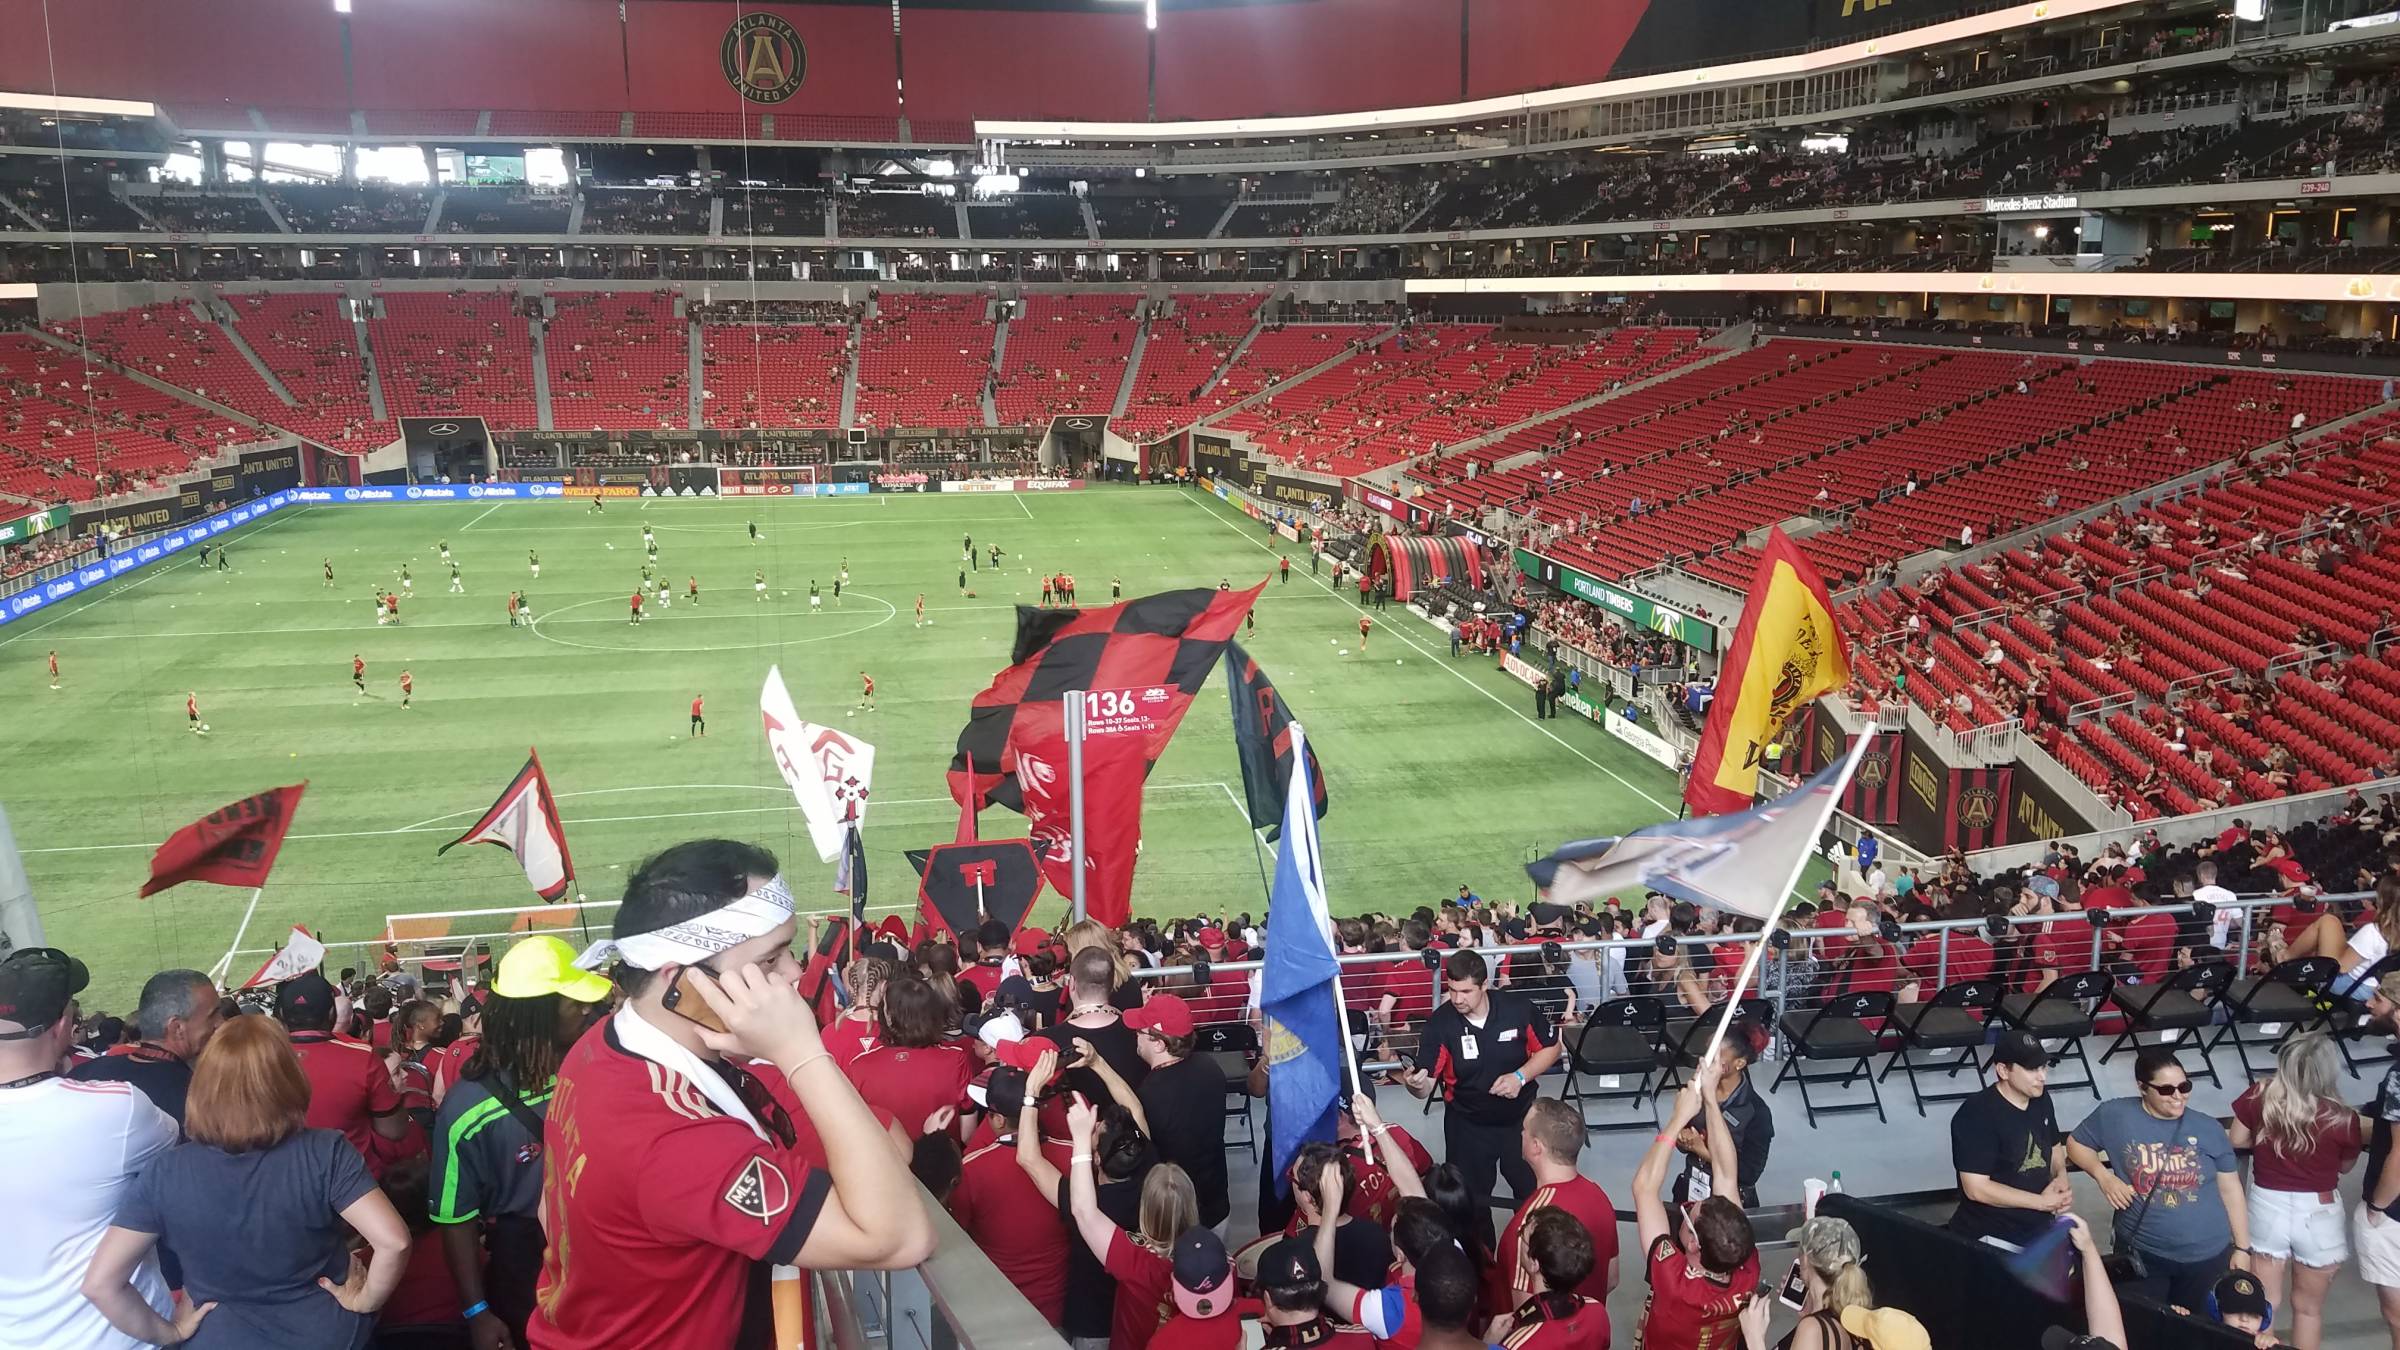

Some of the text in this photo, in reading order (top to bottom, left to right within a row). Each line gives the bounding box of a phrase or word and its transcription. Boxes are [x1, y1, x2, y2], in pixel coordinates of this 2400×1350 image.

[732, 15, 793, 39] ATLANTA
[733, 76, 799, 101] UNITED FC
[2302, 183, 2330, 193] 239-240
[1986, 197, 2042, 212] Mercedes-Benz
[2043, 195, 2078, 209] Stadium
[265, 456, 294, 471] UNITED
[422, 489, 455, 497] Allstate
[484, 487, 516, 496] Allstate
[563, 487, 639, 496] WELLS FARGO
[1027, 481, 1070, 490] EQUIFAX
[1275, 485, 1305, 502] ATLANTA
[299, 491, 332, 501] Allstate
[360, 490, 393, 499] Allstate
[133, 508, 170, 528] UNITED
[1547, 565, 1553, 580] 0
[1574, 577, 1634, 613] PORTLAND TIMBERS
[1504, 655, 1546, 690] ADVOCAR
[1087, 690, 1135, 717] 136
[1105, 717, 1122, 725] 10-37
[1623, 726, 1662, 757] Georgia Power
[731, 1174, 757, 1204] MLS
